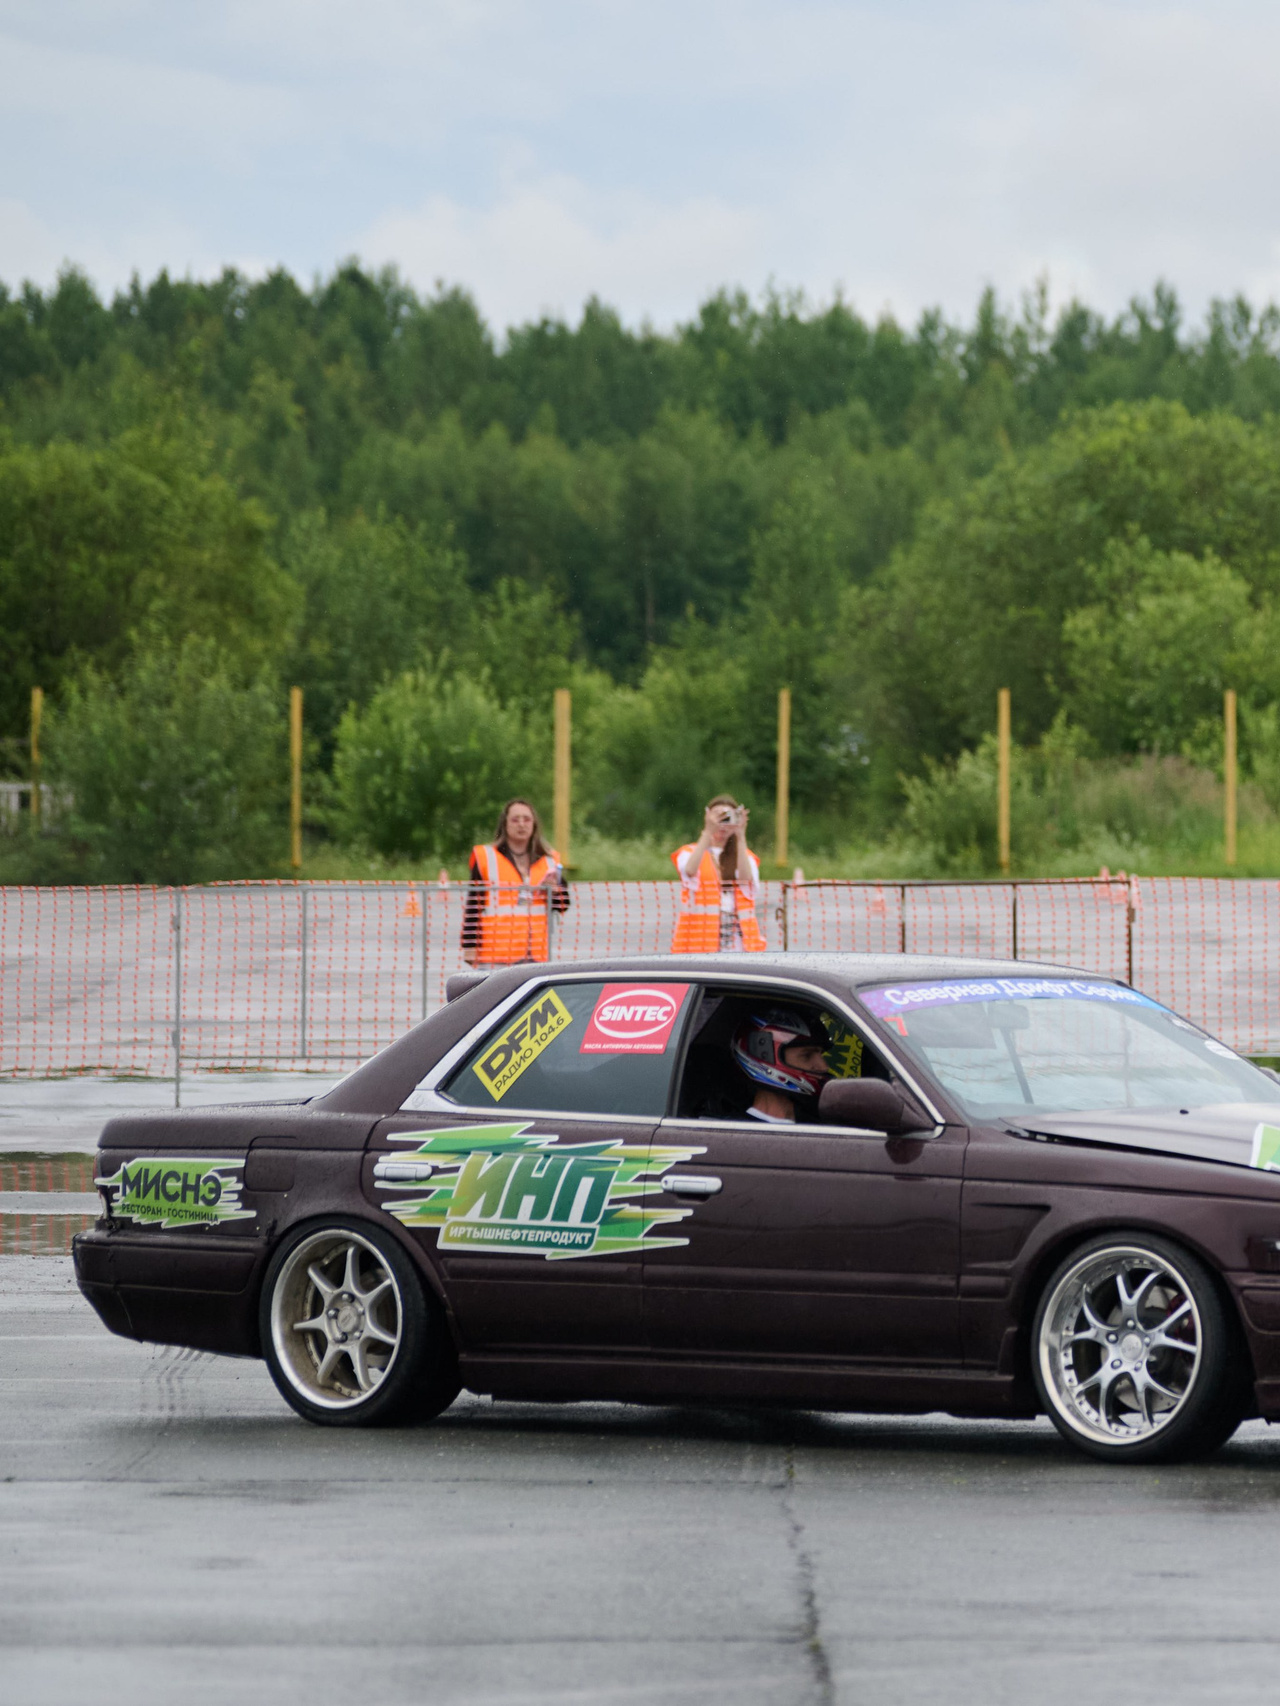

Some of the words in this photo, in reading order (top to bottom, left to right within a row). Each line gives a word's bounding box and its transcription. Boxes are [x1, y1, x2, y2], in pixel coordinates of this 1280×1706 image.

[884, 982, 1001, 1006] Северная
[1003, 979, 1071, 999] Дрифт
[599, 1005, 671, 1021] SINTEC
[481, 997, 559, 1082] DFM
[495, 1047, 533, 1092] РАДИО
[534, 1016, 565, 1047] 104.6
[122, 1166, 222, 1206] МИСНЭ
[448, 1151, 625, 1224] ИНП
[121, 1203, 162, 1216] РЕСТОРАН
[167, 1208, 219, 1222] ГОСТИНИЦА
[449, 1226, 592, 1245] ИРТЫШНЕФТЕПРОДУКТ
